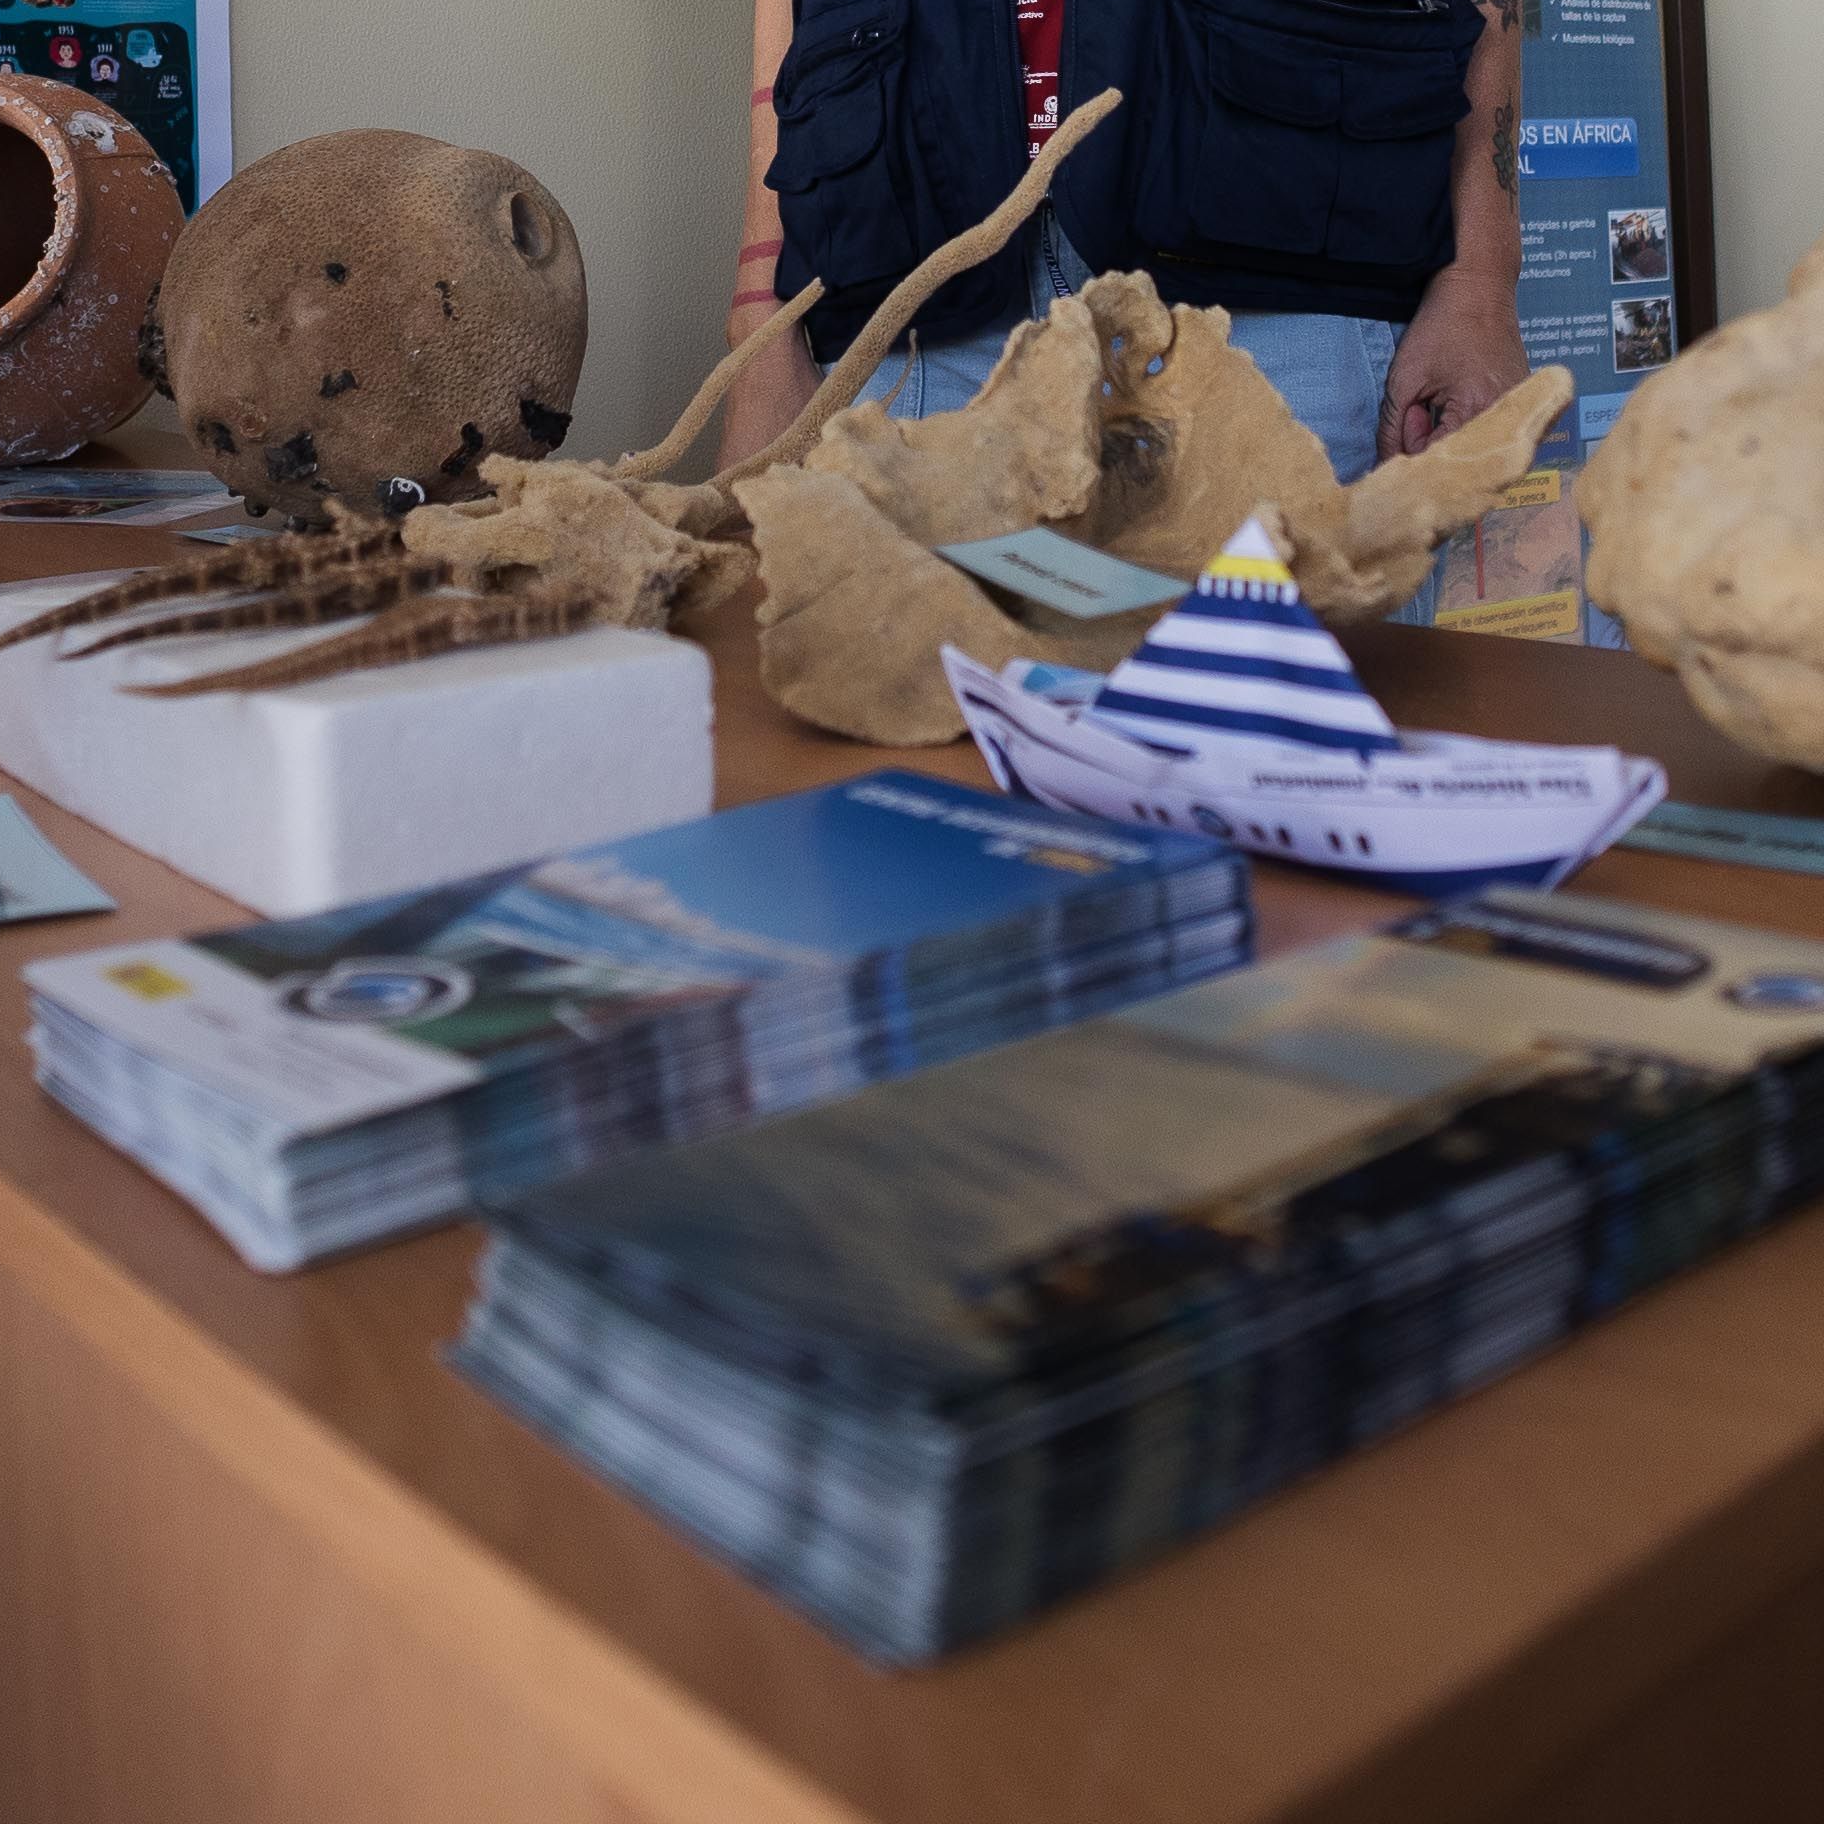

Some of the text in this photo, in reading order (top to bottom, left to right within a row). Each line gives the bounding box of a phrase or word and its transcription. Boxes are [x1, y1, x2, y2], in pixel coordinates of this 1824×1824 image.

[1592, 0, 1600, 9] de
[1561, 10, 1626, 24] tallas de la captura
[1563, 33, 1634, 46] Muestreos biológicos
[1544, 120, 1632, 145] EN ÁFRICA
[1527, 220, 1560, 232] dirigidas
[1568, 219, 1596, 232] gamba
[1573, 313, 1607, 325] especies
[1519, 491, 1546, 506] pesca
